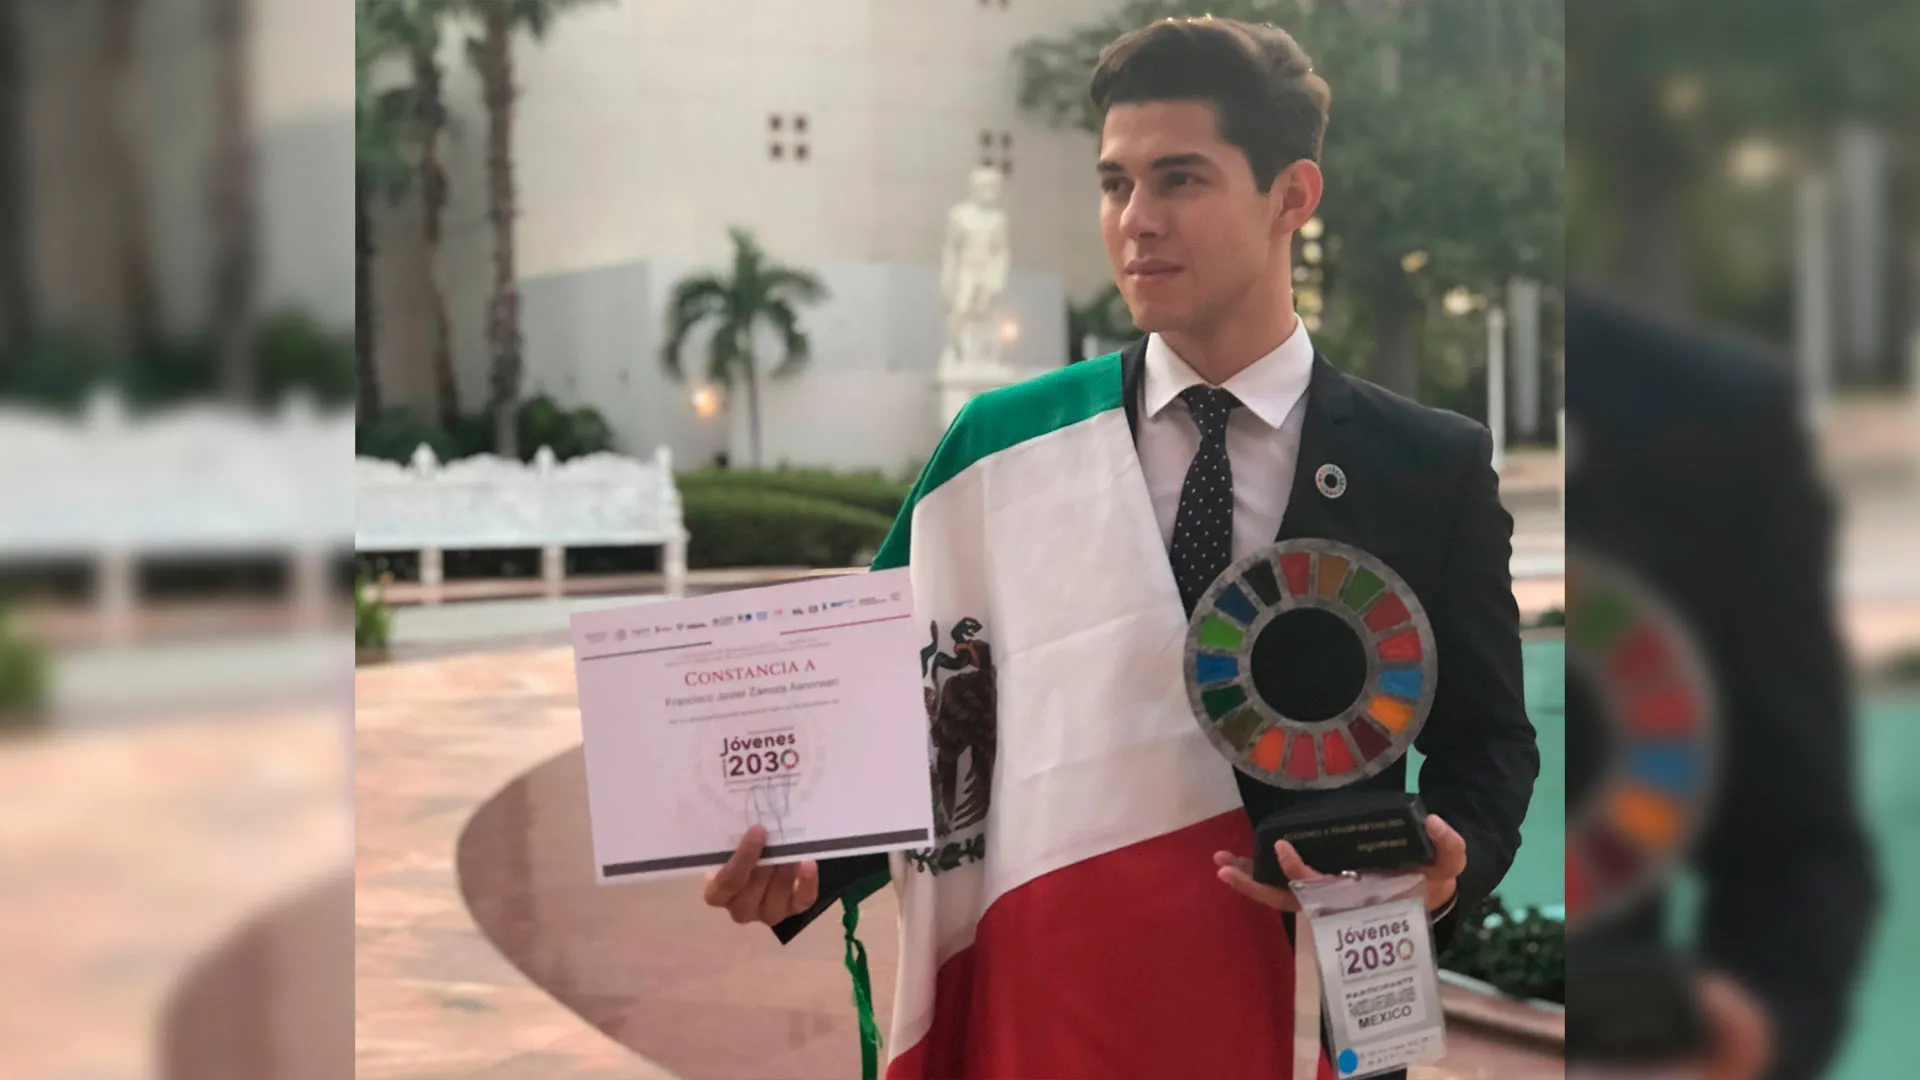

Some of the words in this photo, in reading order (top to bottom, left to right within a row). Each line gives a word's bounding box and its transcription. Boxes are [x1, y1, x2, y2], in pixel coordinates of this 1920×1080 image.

[684, 661, 800, 687] CONSTANCIA
[805, 659, 816, 671] A
[664, 694, 714, 707] Francisco
[717, 690, 746, 702] Javier
[749, 685, 788, 697] Zamora
[719, 733, 796, 757] Jóvenes
[729, 749, 800, 777] 2030
[1334, 918, 1410, 952] Jóvenes
[1344, 937, 1415, 975] 2030
[1358, 1005, 1412, 1030] MEXICO
